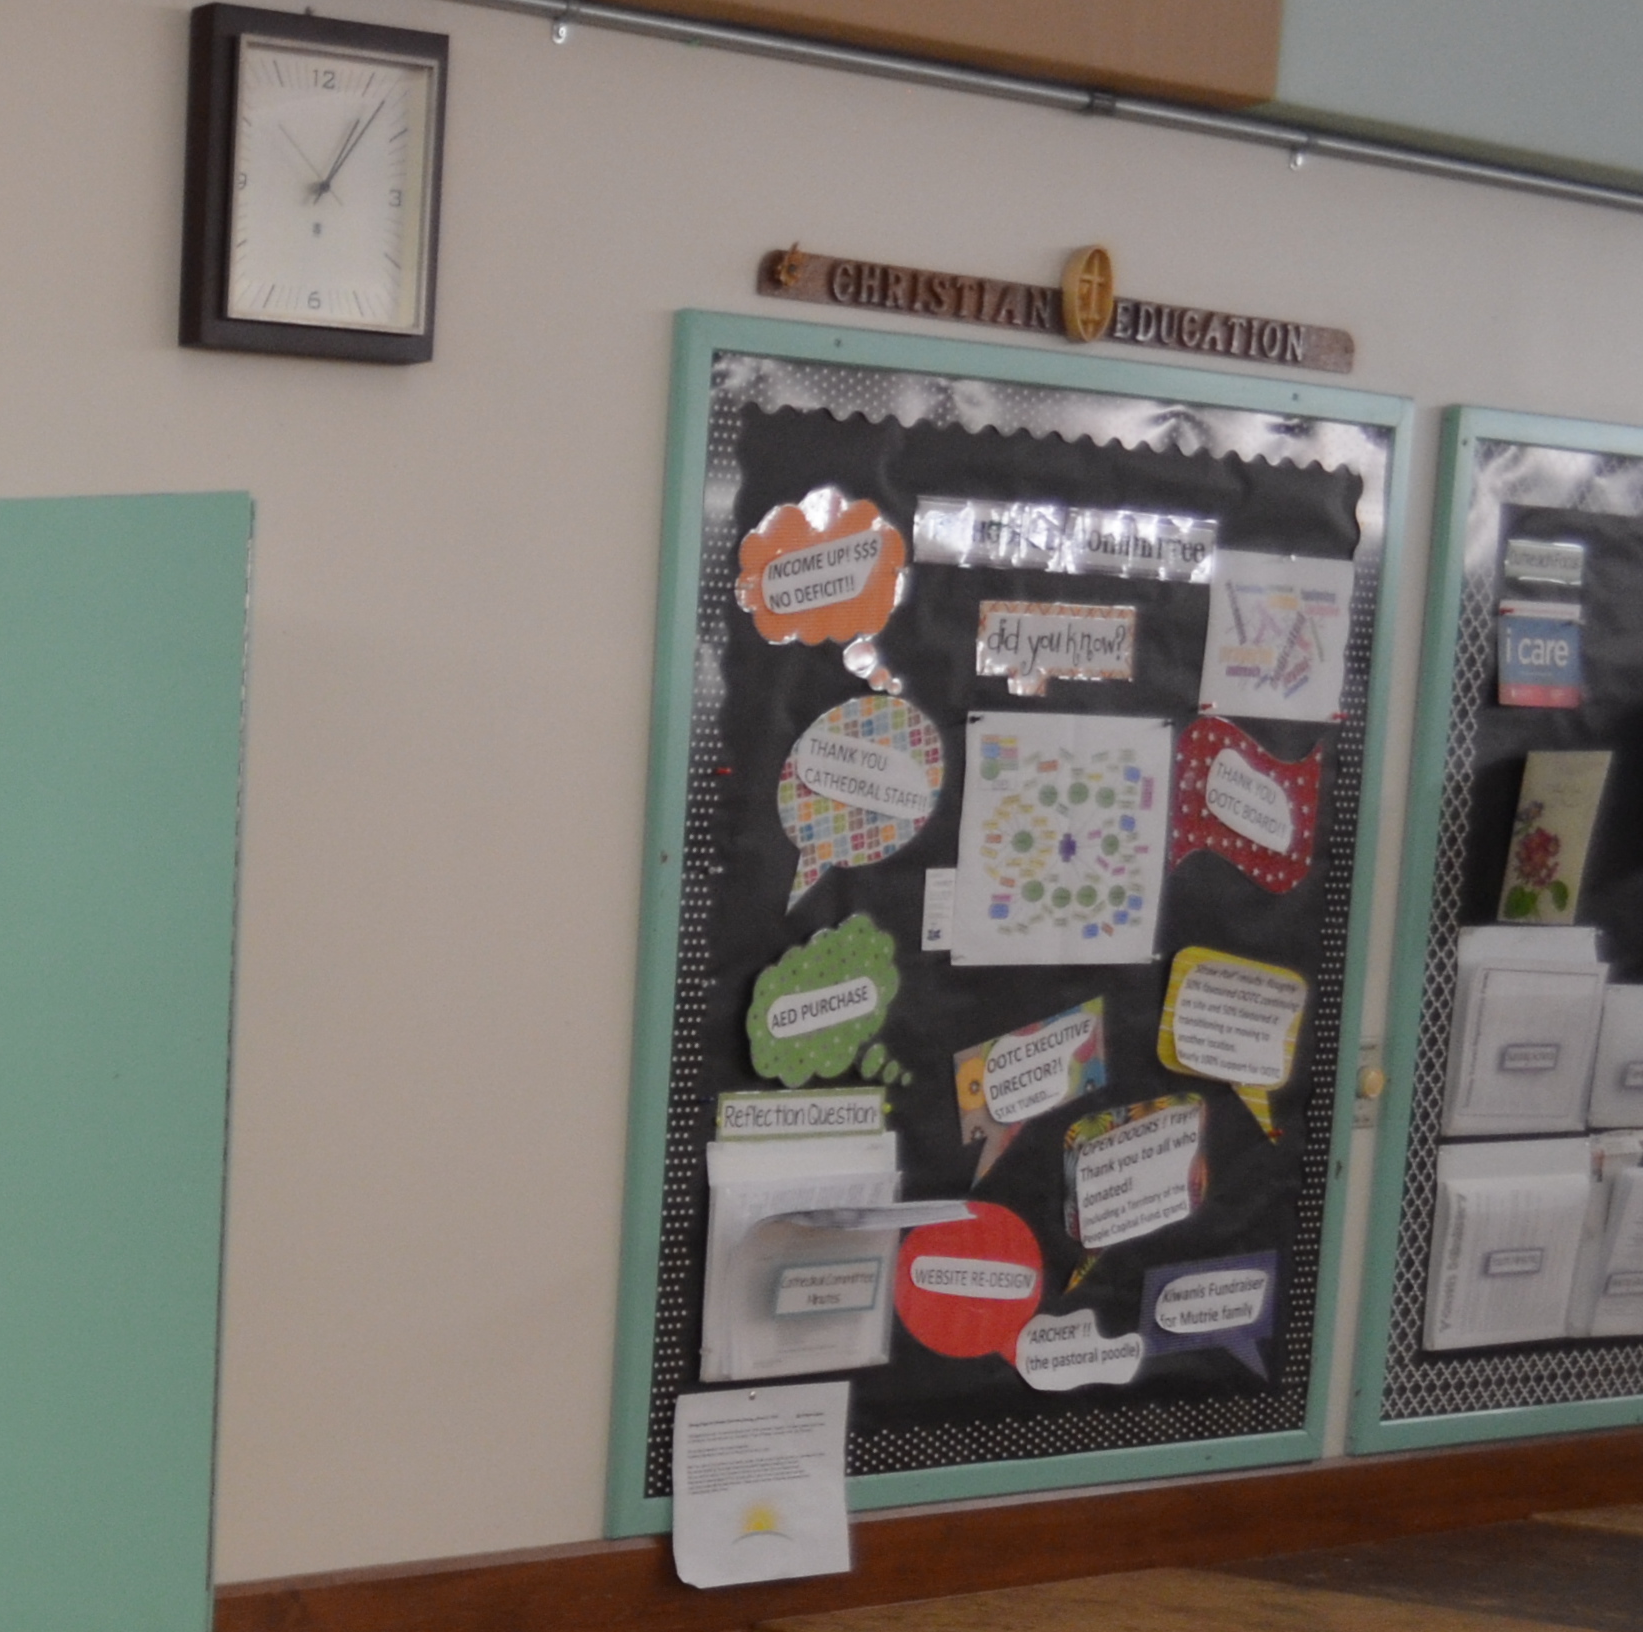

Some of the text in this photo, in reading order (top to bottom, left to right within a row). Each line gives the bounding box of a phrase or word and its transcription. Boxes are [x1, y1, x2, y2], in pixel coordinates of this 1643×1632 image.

[312, 70, 336, 90] 12
[236, 173, 248, 190] 9
[389, 189, 403, 208] 3
[308, 291, 322, 309] 6
[832, 262, 1307, 363] CHRISTIAN EDUCATION
[768, 553, 823, 581] INCOME
[827, 544, 851, 567] UP!
[769, 575, 855, 609] NO DEFICIT!!
[988, 619, 1126, 675] did you know?
[1506, 627, 1570, 668] i care
[810, 738, 888, 772] THANK YOU
[805, 768, 928, 812] CATHEDRAL STAFF!!
[1216, 762, 1277, 805] THANK YOU
[1208, 788, 1241, 815] OOTC
[771, 985, 869, 1029] AED PURCHASE
[987, 1019, 1091, 1074] OOTC EXECUTIVE
[989, 1057, 1064, 1101] DIRECTOR?!
[724, 1104, 805, 1128] Reflection
[994, 1103, 1017, 1119] STAY
[1080, 1131, 1197, 1182] Thank you to all who
[1083, 1177, 1133, 1208] donated!
[1172, 1183, 1186, 1195] the
[1111, 1217, 1139, 1236] Capital
[1140, 1209, 1161, 1223] Fund
[914, 1267, 1033, 1290] WEBSITE RE-DESIGN
[1161, 1276, 1266, 1304] Kiwanis Fundraiser
[1160, 1303, 1253, 1329] for Mutrie family
[1025, 1342, 1140, 1375] (the pastoral poodle)
